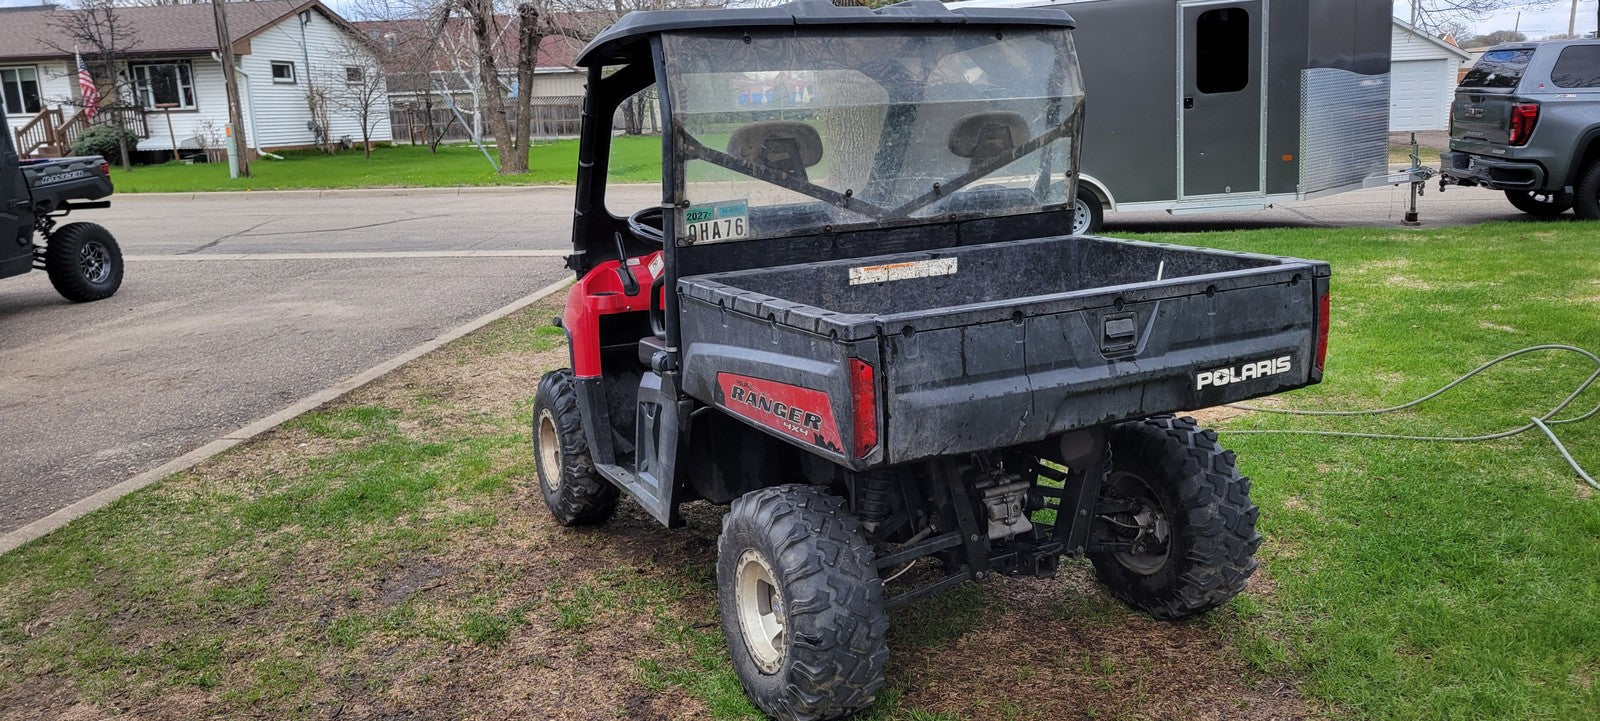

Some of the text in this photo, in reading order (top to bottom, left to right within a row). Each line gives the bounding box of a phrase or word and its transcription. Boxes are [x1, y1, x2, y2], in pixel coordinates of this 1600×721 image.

[686, 211, 708, 221] 2027
[1196, 355, 1291, 391] POLARIS
[731, 384, 823, 432] RANGER
